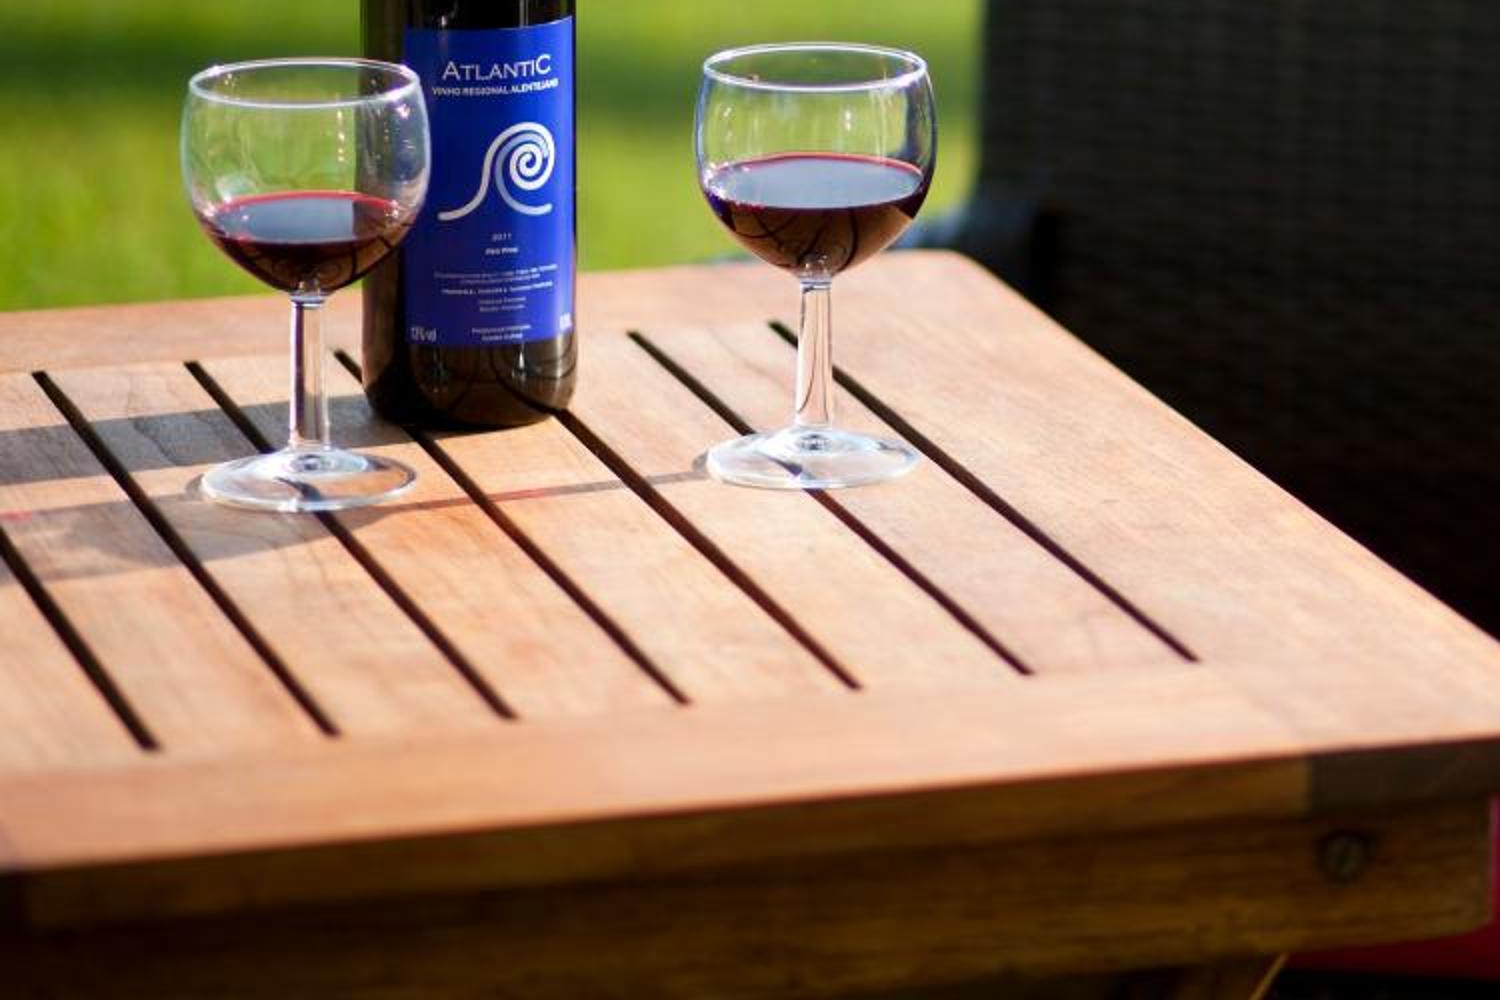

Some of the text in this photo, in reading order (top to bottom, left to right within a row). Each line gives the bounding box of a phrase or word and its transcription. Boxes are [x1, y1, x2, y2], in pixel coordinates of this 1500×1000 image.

[442, 53, 551, 81] ATLANTIC
[432, 86, 461, 97] VINHO
[462, 85, 510, 96] REGIONAL
